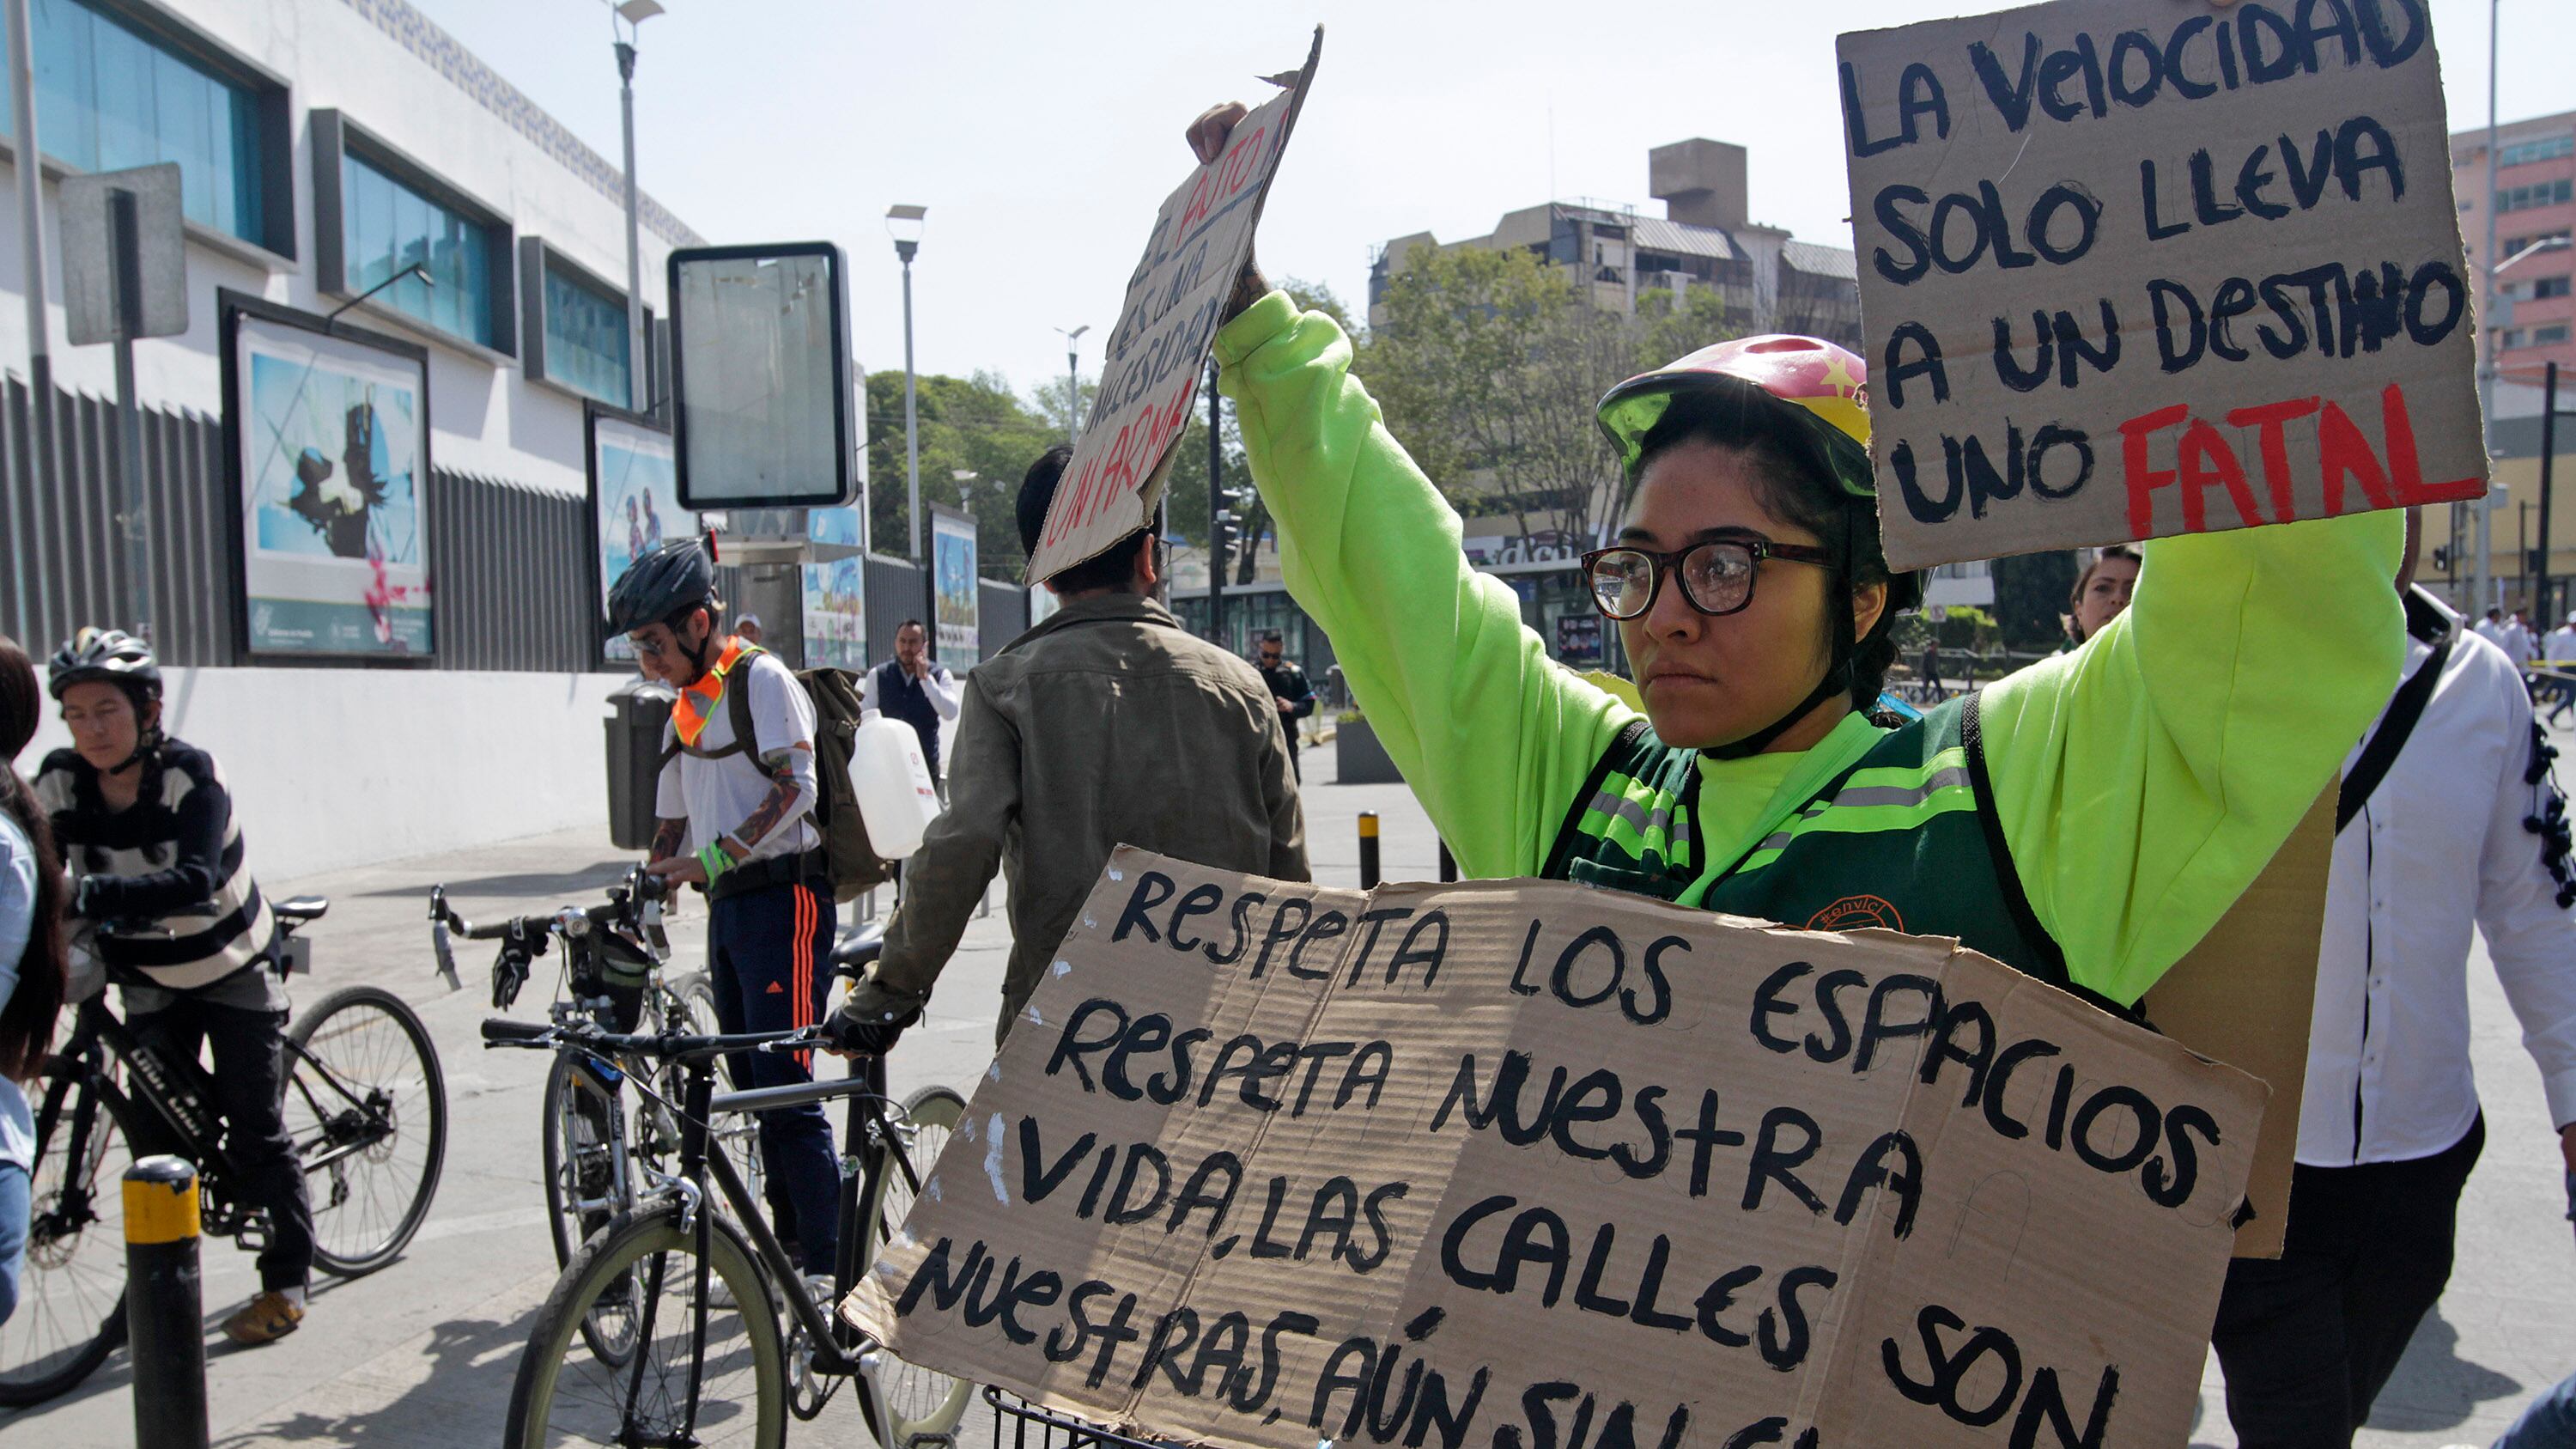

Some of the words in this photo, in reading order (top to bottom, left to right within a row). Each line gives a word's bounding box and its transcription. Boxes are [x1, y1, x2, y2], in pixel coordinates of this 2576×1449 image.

[1839, 60, 1950, 158] LA
[1133, 216, 1171, 288] EL
[1176, 126, 1265, 248] AUTO
[1874, 179, 2103, 285] SOLO
[2142, 117, 2405, 240] LLEVA
[1086, 295, 1217, 435] NECESIDAD
[1116, 287, 1155, 362] ES
[1153, 240, 1208, 326] UNA
[1886, 322, 1950, 410] A
[1992, 298, 2120, 392] UN
[1047, 443, 1106, 549] UN
[1891, 417, 2094, 523] UNO
[1510, 918, 1692, 1026] LOS
[1750, 961, 2221, 1209] ESPACIOS
[1249, 1175, 1411, 1274] LAS
[1440, 1195, 1838, 1373] CALLES
[1881, 1304, 2120, 1449] SON
